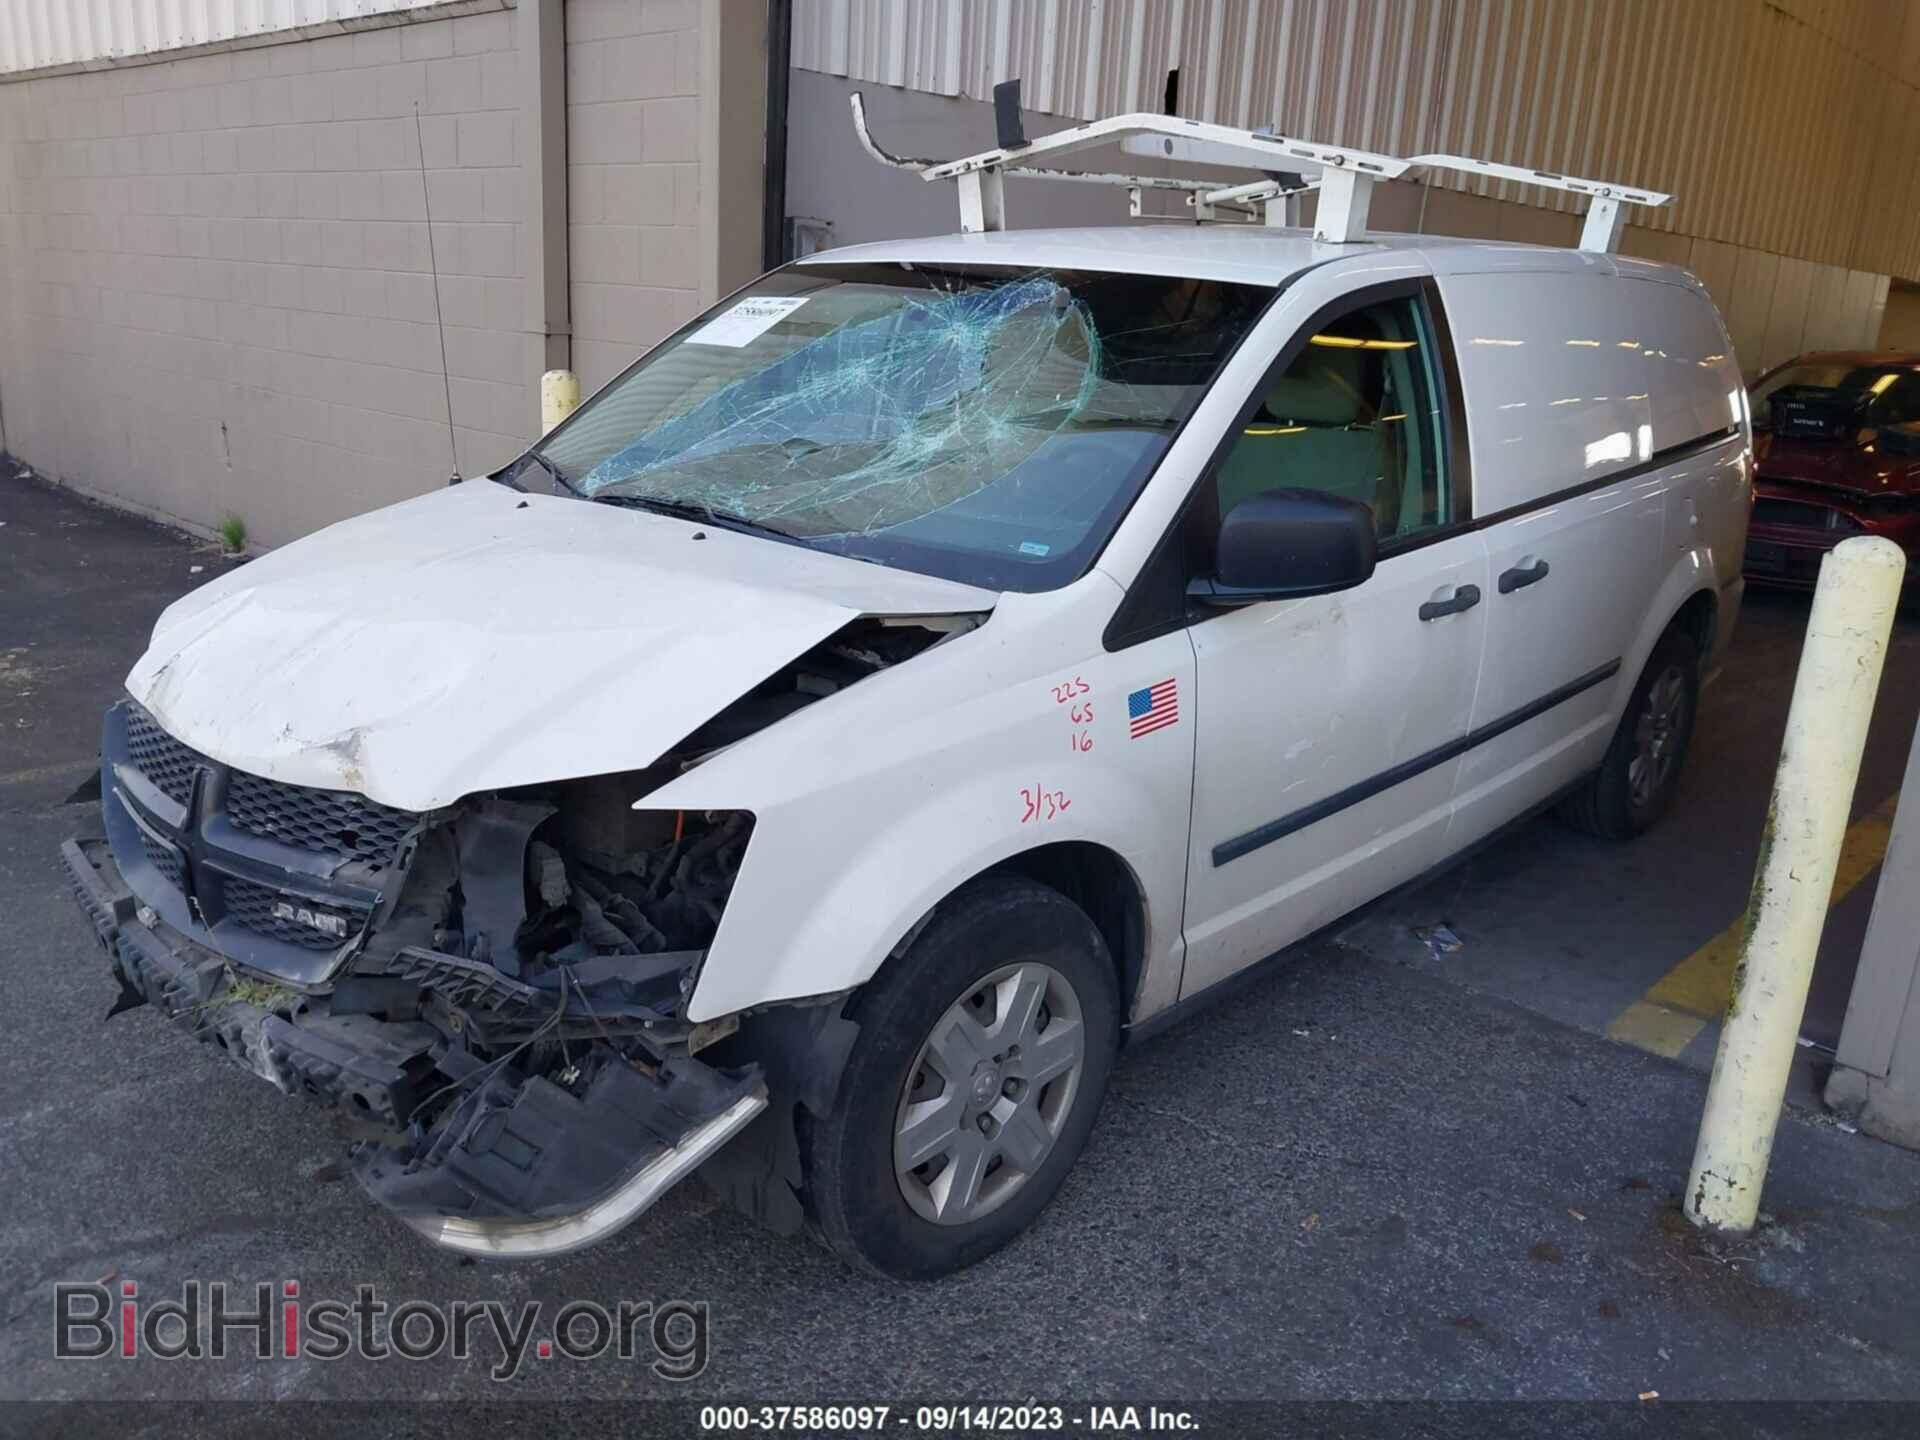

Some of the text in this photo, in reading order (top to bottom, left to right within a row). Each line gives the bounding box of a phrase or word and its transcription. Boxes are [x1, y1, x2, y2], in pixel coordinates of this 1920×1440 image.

[1051, 676, 1090, 703] 225
[1071, 702, 1094, 723] 65
[1072, 730, 1093, 752] 16
[1020, 783, 1071, 823] 3/32
